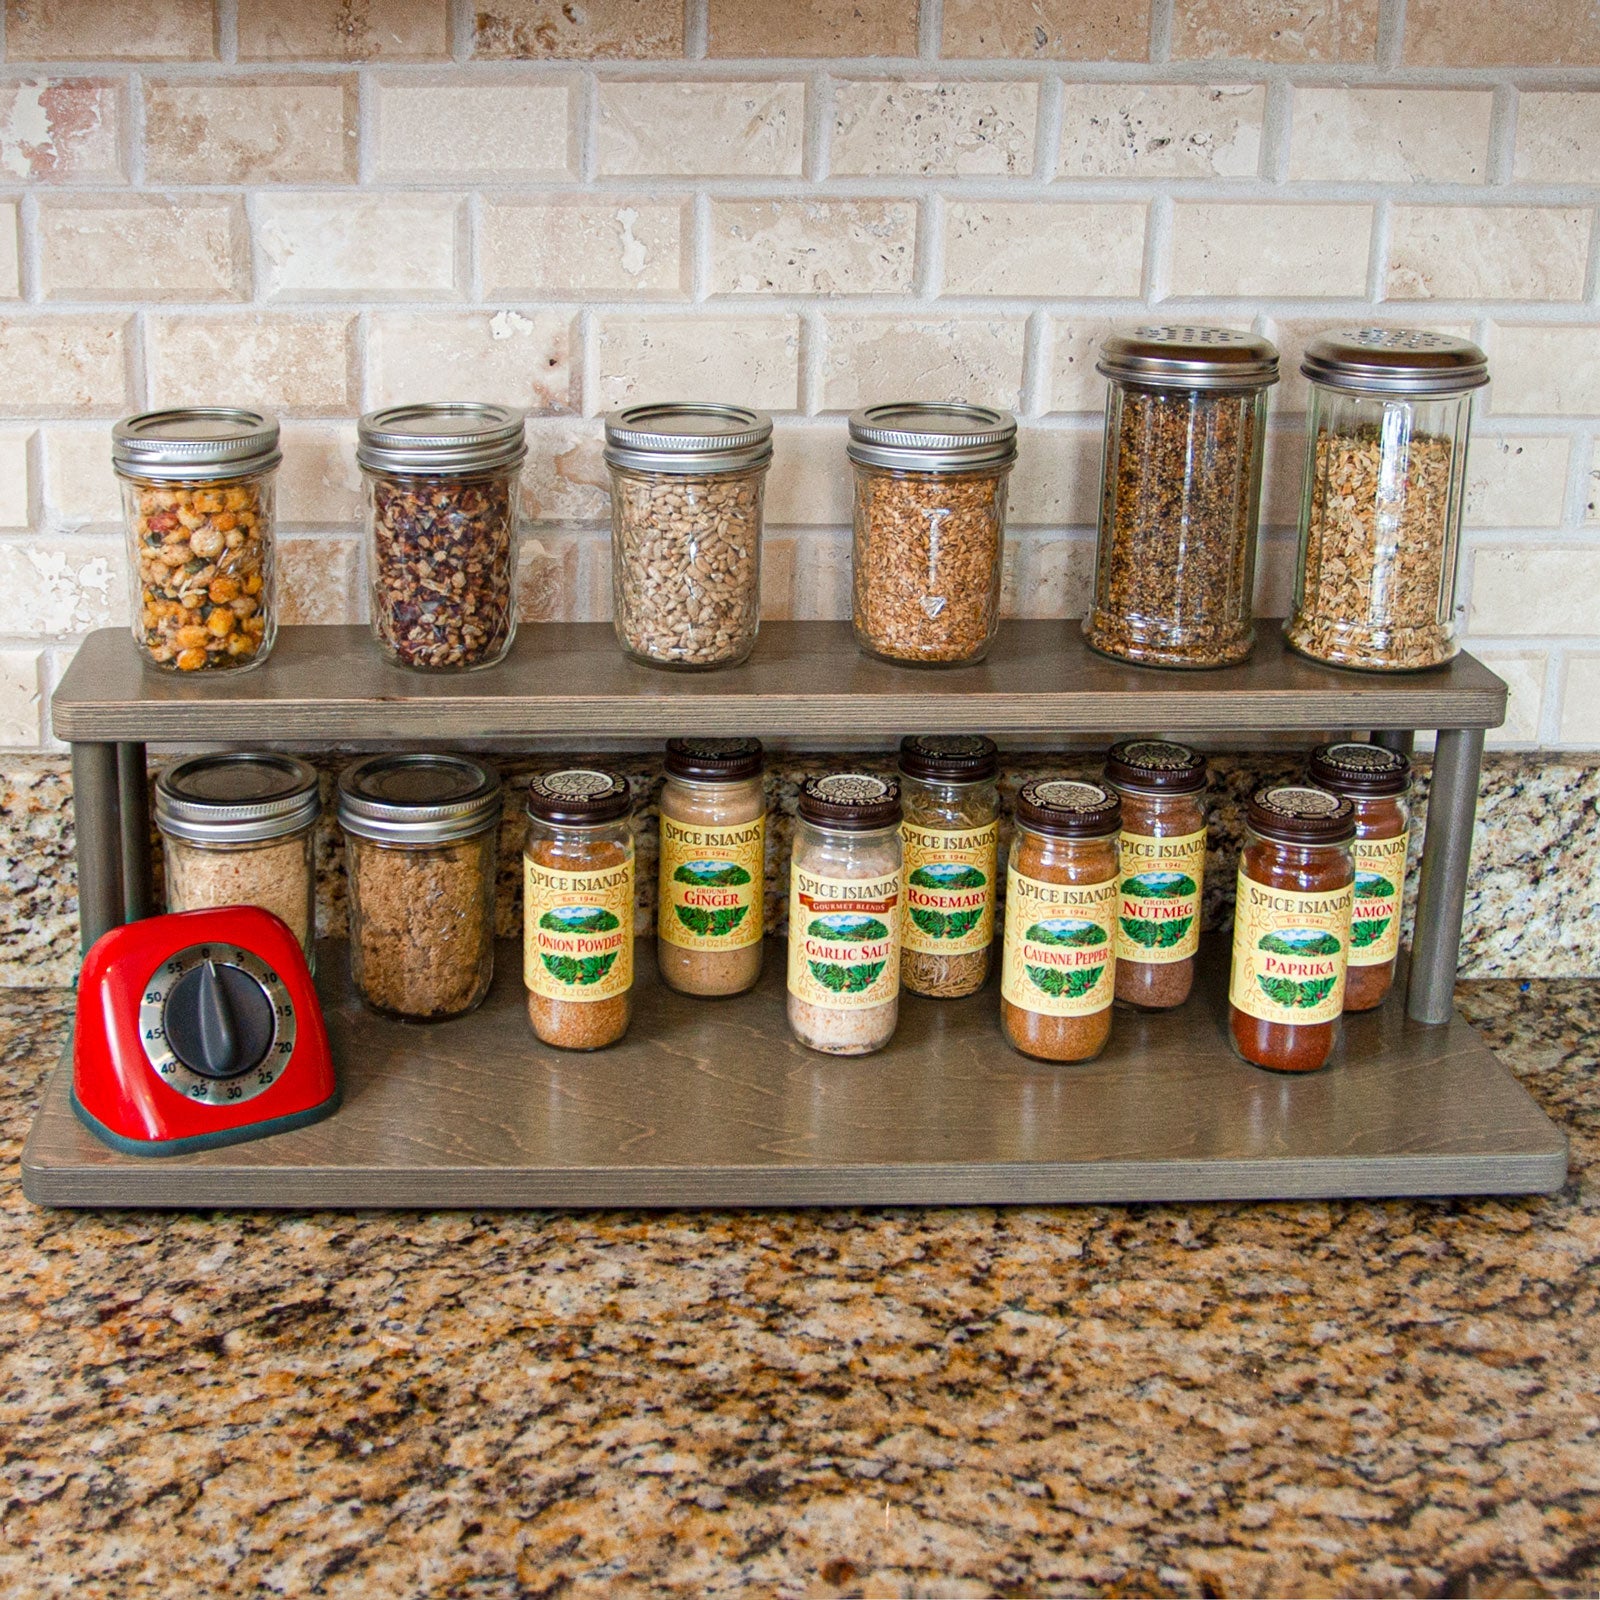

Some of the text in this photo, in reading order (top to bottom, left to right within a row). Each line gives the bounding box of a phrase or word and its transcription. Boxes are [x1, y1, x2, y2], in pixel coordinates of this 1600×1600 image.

[666, 822, 761, 847] SPICE ISLANDS
[901, 826, 996, 850] SPICE ISLANDS
[1159, 834, 1206, 858] ISLANDS
[1353, 837, 1406, 857] ISLANDS
[530, 867, 629, 892] SPICE ISLANDS
[799, 874, 898, 900] SPICE ISLANDS
[684, 890, 740, 907] GINGER
[908, 888, 988, 908] ROSEMARY
[1018, 878, 1118, 904] SPICE ISLANDS
[813, 902, 886, 911] GOURMET BLENDS
[1250, 887, 1352, 914] SPICE ISLANDS
[1123, 901, 1194, 919] NUTMEG
[1352, 902, 1394, 918] AMON
[538, 932, 623, 953] ONION POWDER
[806, 940, 891, 961] GARLIC SALT
[202, 948, 210, 958] 0
[236, 952, 244, 962] 5
[1024, 944, 1109, 966] CAYENNE PEPPER
[168, 962, 182, 974] 55
[1265, 957, 1334, 976] PAPRIKA
[264, 972, 278, 984] 10
[146, 992, 162, 1004] 50
[280, 1006, 292, 1016] 15
[146, 1028, 161, 1040] 45
[279, 1042, 292, 1054] 20
[161, 1062, 176, 1074] 40
[258, 1072, 273, 1084] 25
[192, 1084, 208, 1096] 35
[226, 1087, 242, 1100] 30
